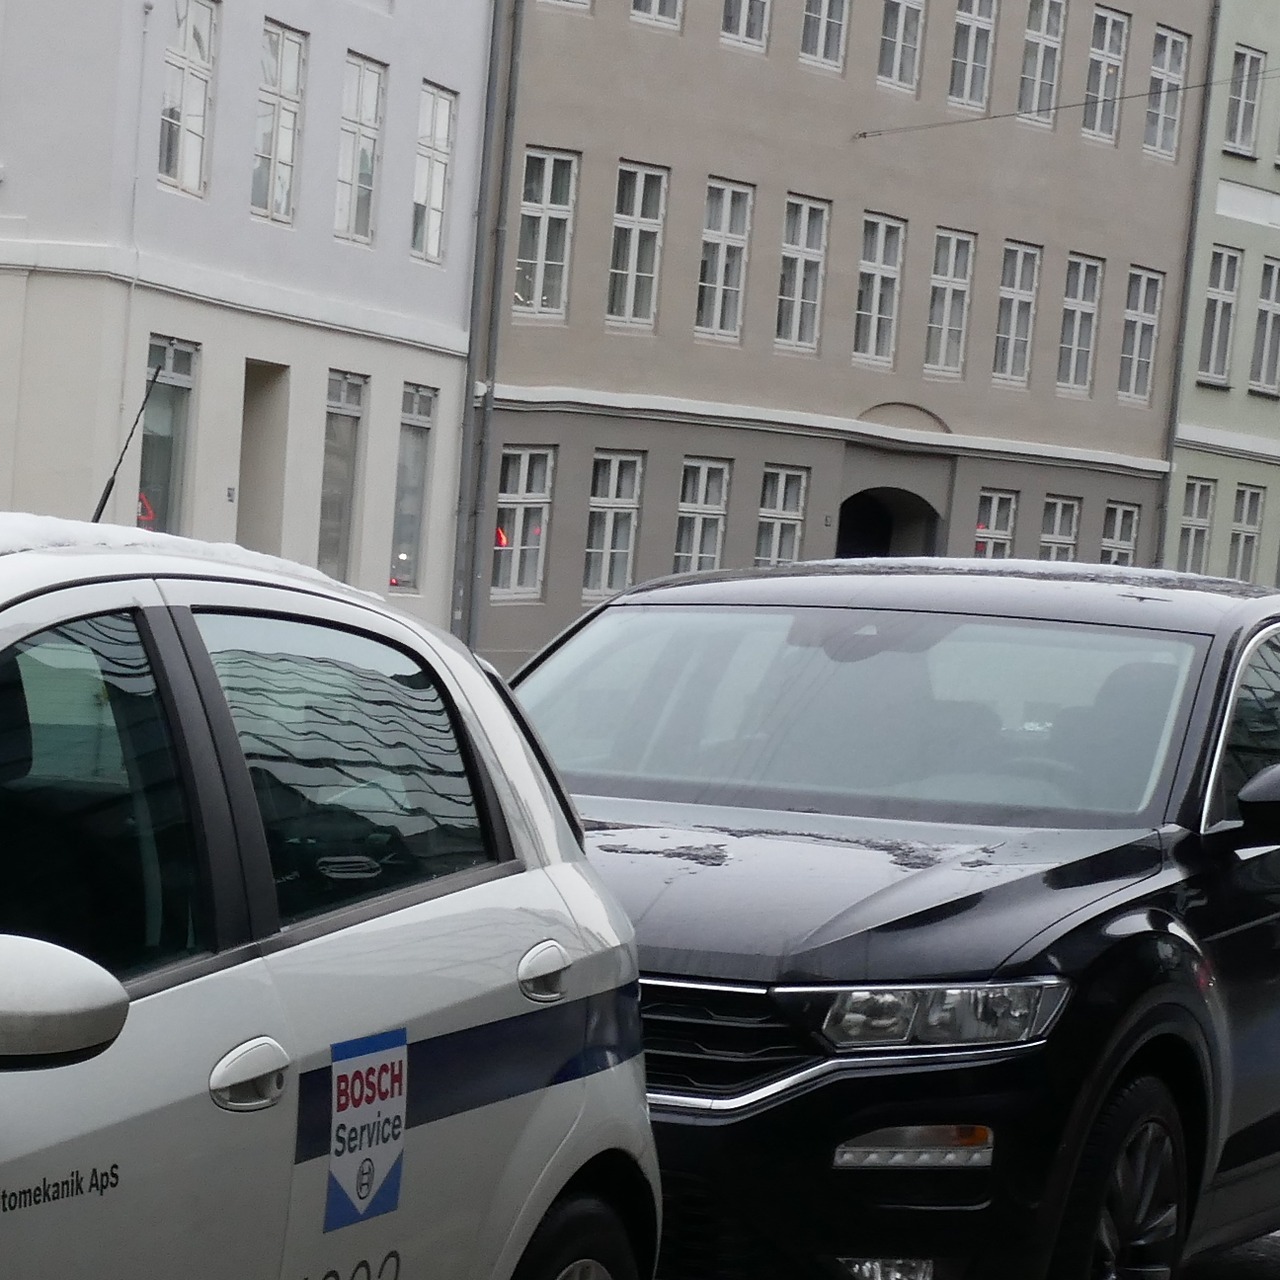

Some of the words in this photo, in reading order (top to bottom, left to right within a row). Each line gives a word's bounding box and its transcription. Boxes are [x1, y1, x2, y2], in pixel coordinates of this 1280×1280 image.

[336, 1059, 403, 1113] BOSCH
[334, 1111, 402, 1157] Service
[88, 1163, 119, 1196] ApS
